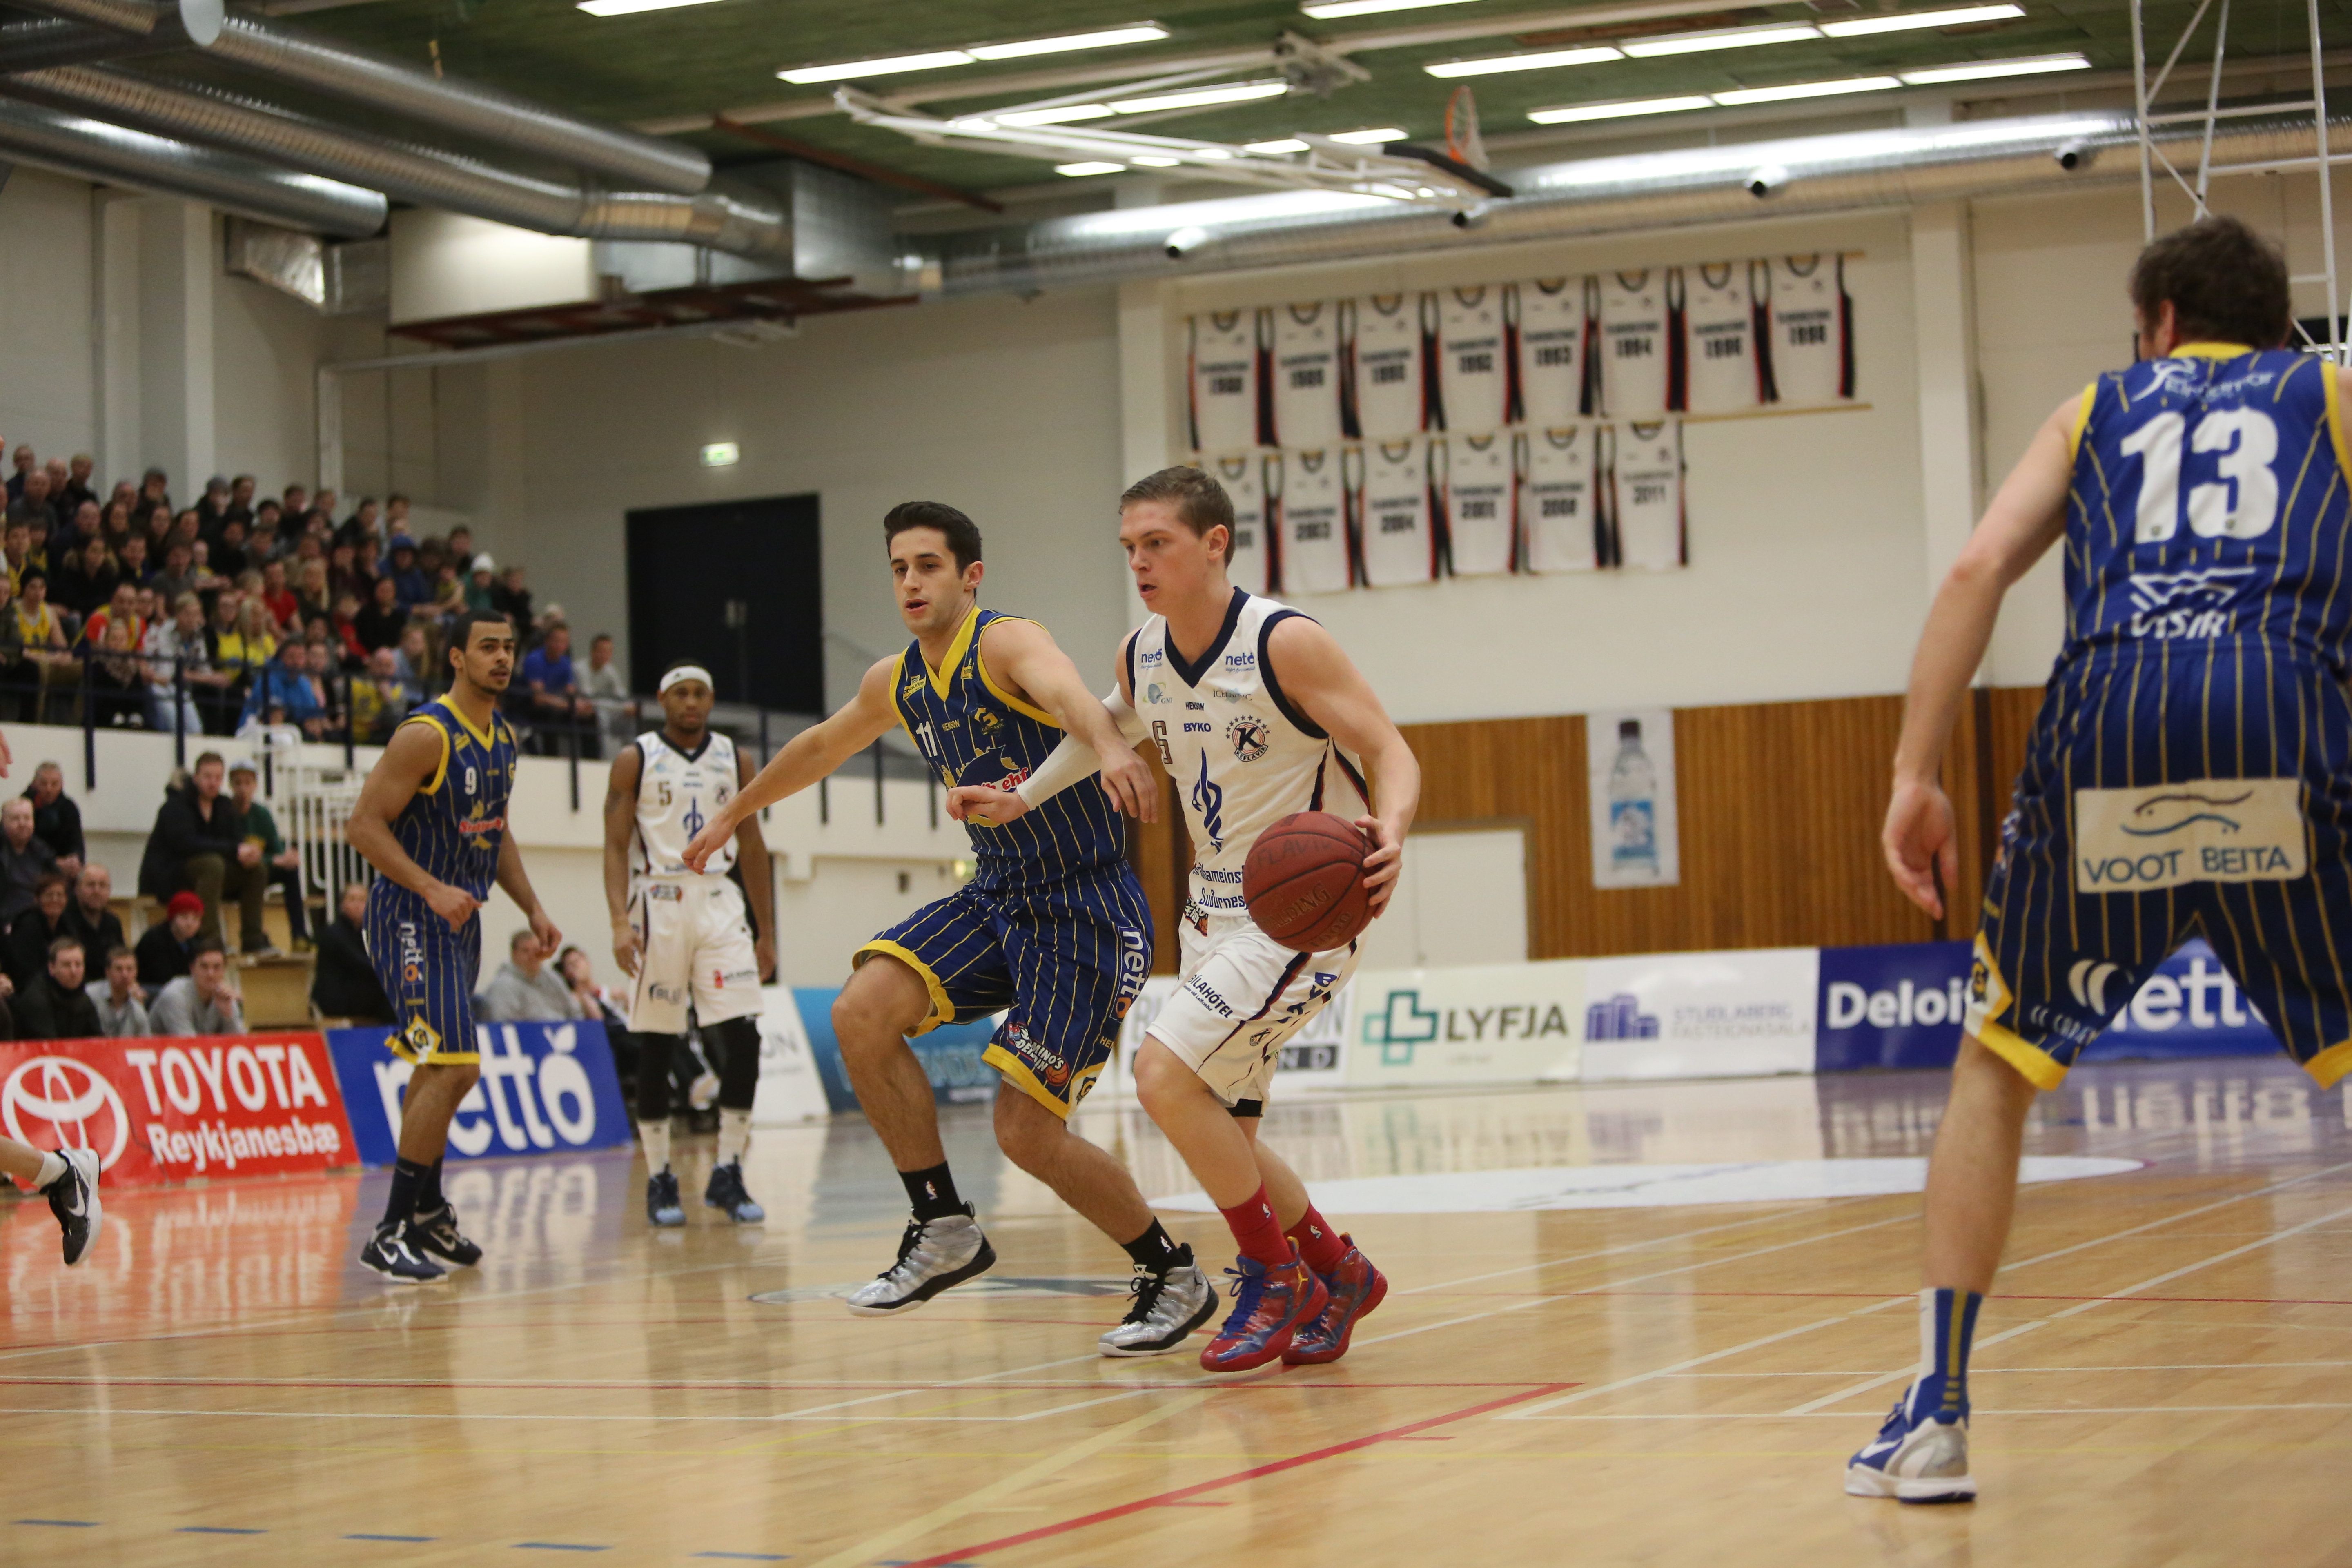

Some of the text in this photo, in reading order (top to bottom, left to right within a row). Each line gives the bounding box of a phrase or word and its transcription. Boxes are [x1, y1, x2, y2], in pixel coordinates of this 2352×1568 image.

[2121, 408, 2278, 544] 13
[1185, 702, 1204, 710] HENSON
[916, 721, 938, 758] 11
[942, 719, 960, 732] HENSON
[1184, 723, 1211, 732] BYKO
[464, 766, 477, 795] 9
[658, 781, 672, 806] 5
[2082, 846, 2292, 884] VOOT BEITA
[1446, 1002, 1569, 1042] LYFJA
[126, 1043, 327, 1115] TOYOTA
[147, 1116, 340, 1171] Reykjanesbæ
